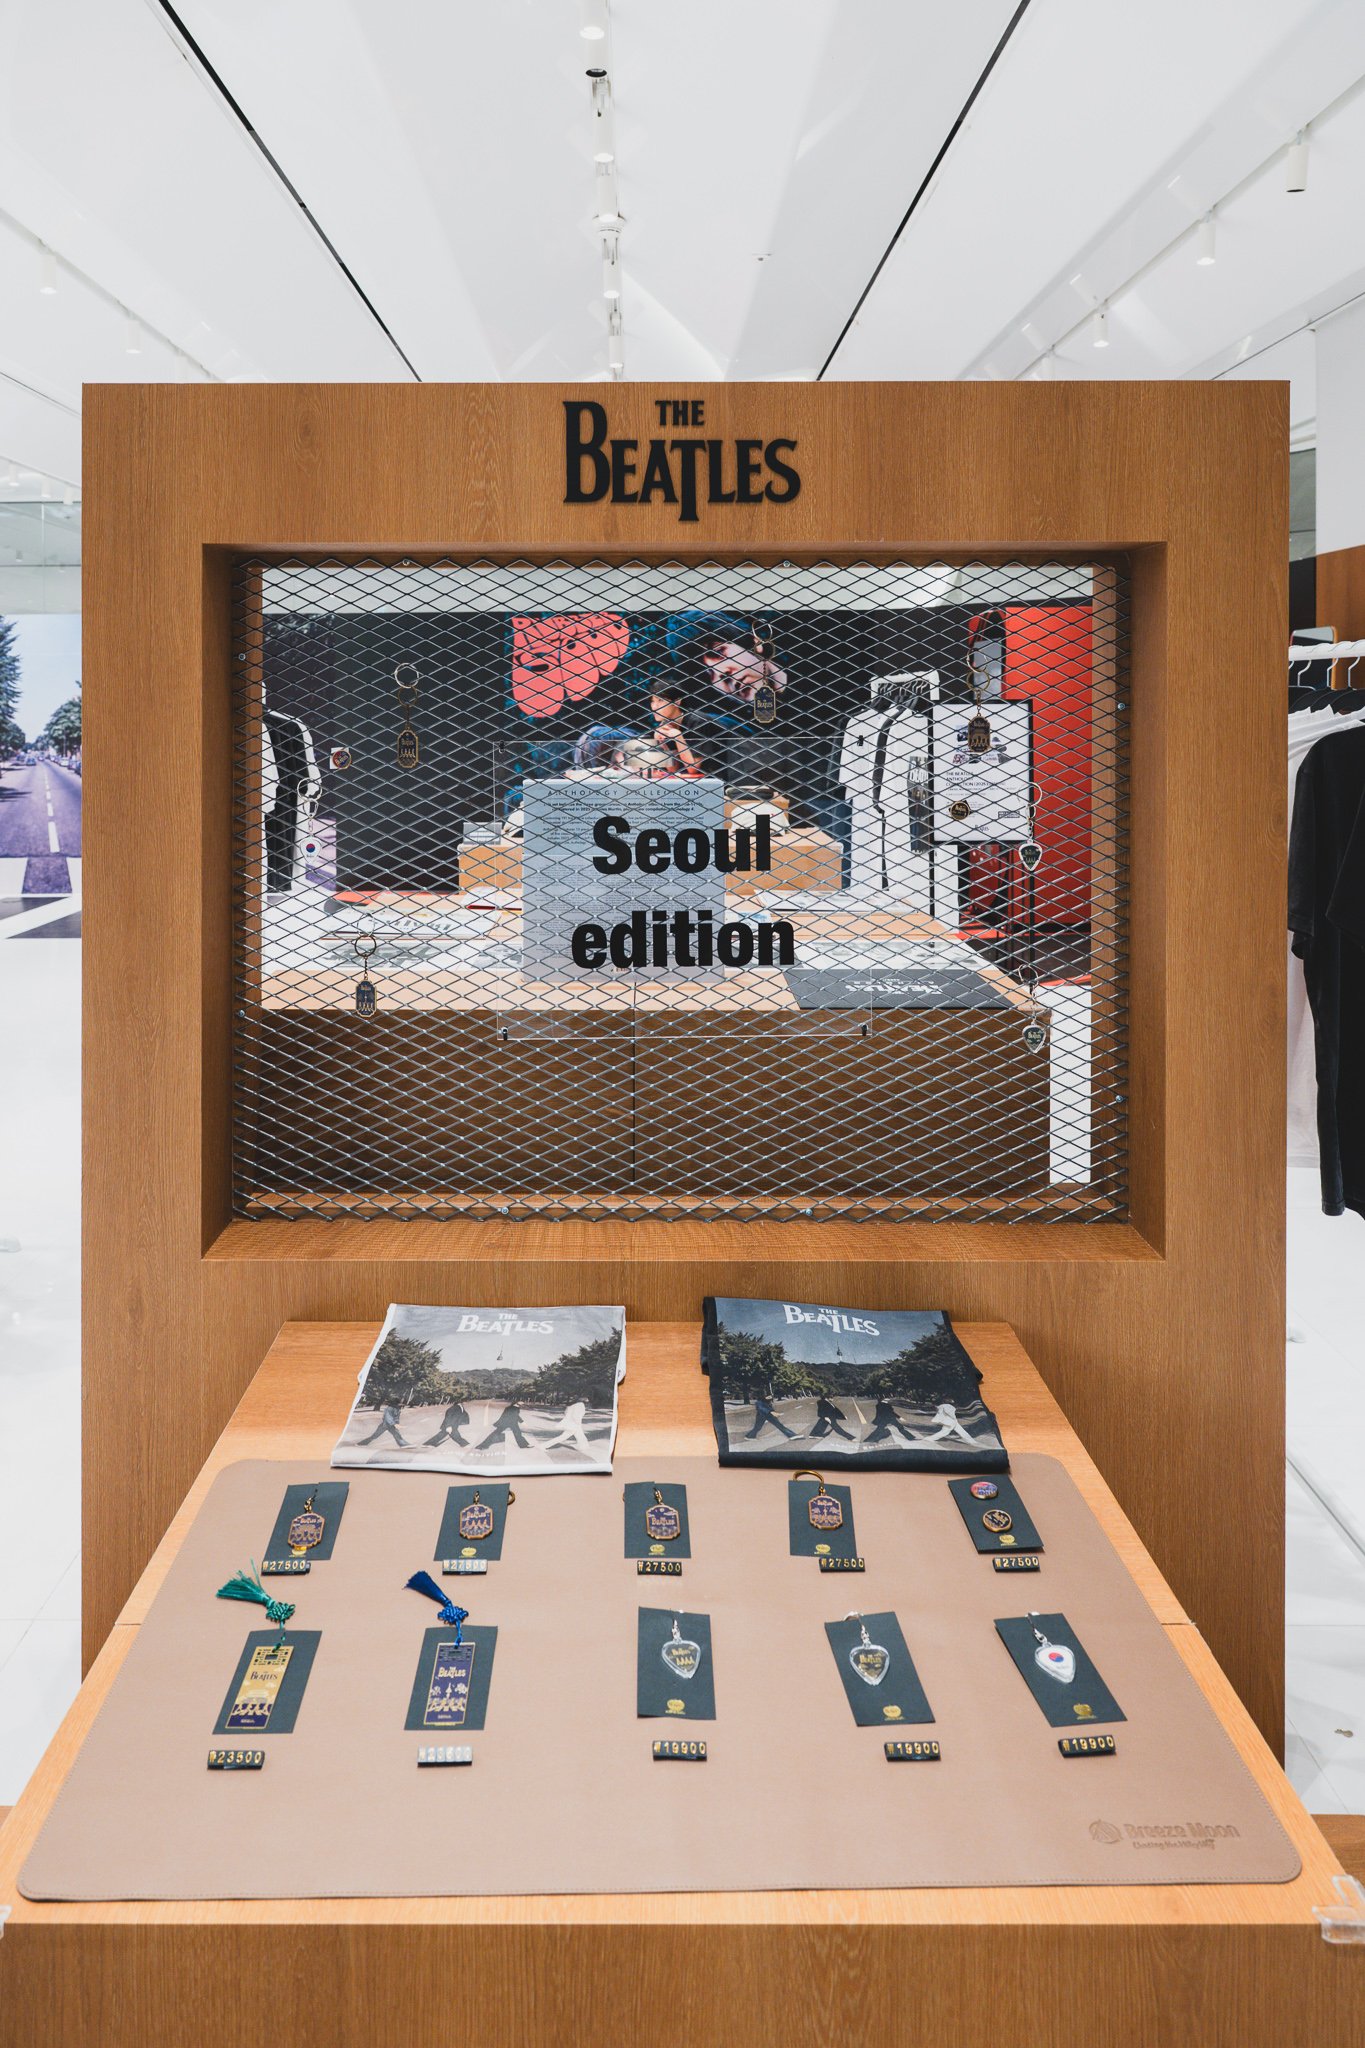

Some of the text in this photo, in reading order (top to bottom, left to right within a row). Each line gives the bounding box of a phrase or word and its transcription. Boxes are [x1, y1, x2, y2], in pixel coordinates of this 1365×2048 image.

[655, 400, 705, 426] THE
[562, 400, 802, 522] BEATLES
[593, 815, 771, 874] Seoul
[572, 910, 795, 968] edition
[457, 1314, 554, 1336] BEATLES
[782, 1303, 880, 1337] BEATLES
[818, 1307, 839, 1315] THE
[1124, 1822, 1240, 1838] Breeze Moon
